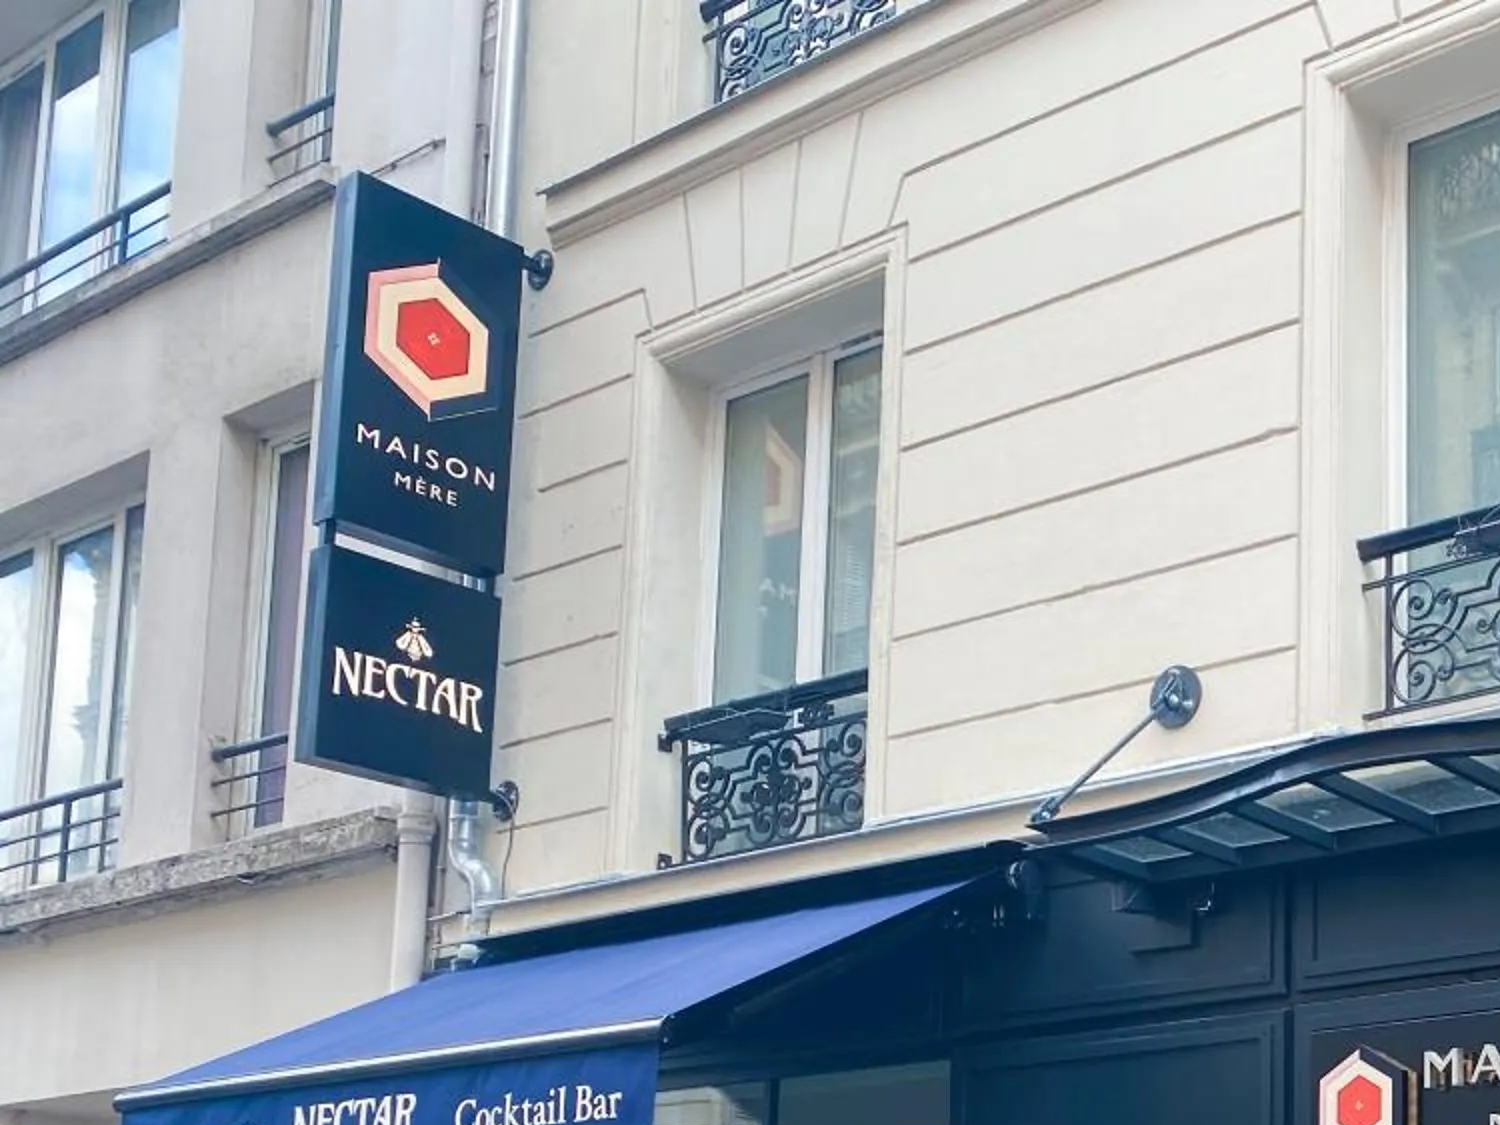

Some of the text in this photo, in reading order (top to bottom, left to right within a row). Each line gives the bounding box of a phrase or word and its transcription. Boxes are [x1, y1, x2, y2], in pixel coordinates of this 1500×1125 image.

[357, 422, 496, 492] MAISON
[394, 470, 459, 507] MÈRE
[331, 645, 484, 734] NECTAR
[573, 1084, 623, 1123] Bar
